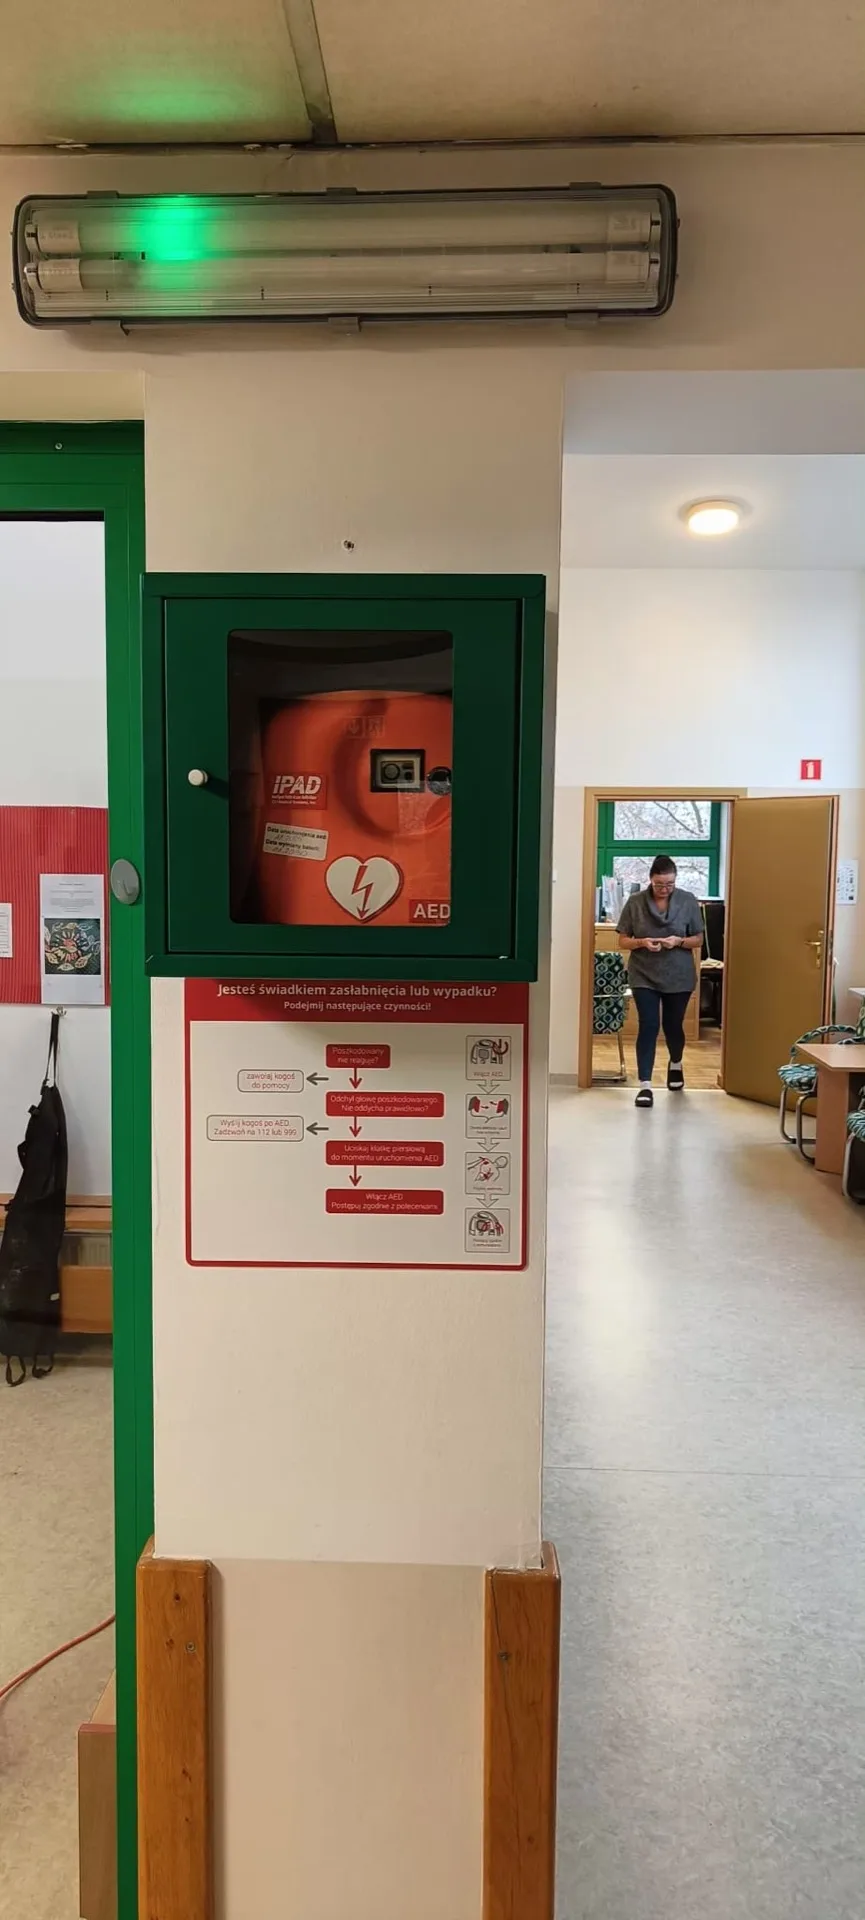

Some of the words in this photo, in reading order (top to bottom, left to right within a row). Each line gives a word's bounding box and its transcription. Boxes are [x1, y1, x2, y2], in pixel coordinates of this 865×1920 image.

[272, 775, 322, 794] IPAD
[413, 904, 450, 918] AED
[218, 984, 255, 997] Jesteś
[258, 984, 326, 996] świadkiem
[330, 984, 406, 998] zasłabnięcia
[409, 985, 430, 996] lub
[432, 986, 498, 999] wypadku?
[284, 1001, 324, 1012] Podejmij
[326, 1002, 382, 1012] następujące
[384, 1002, 432, 1012] czynności!
[274, 1072, 296, 1080] kogoś
[354, 1105, 384, 1113] oddycha
[242, 1120, 262, 1128] kogoś
[214, 1128, 246, 1136] Zadzwoń
[362, 1202, 392, 1211] zgodnie
